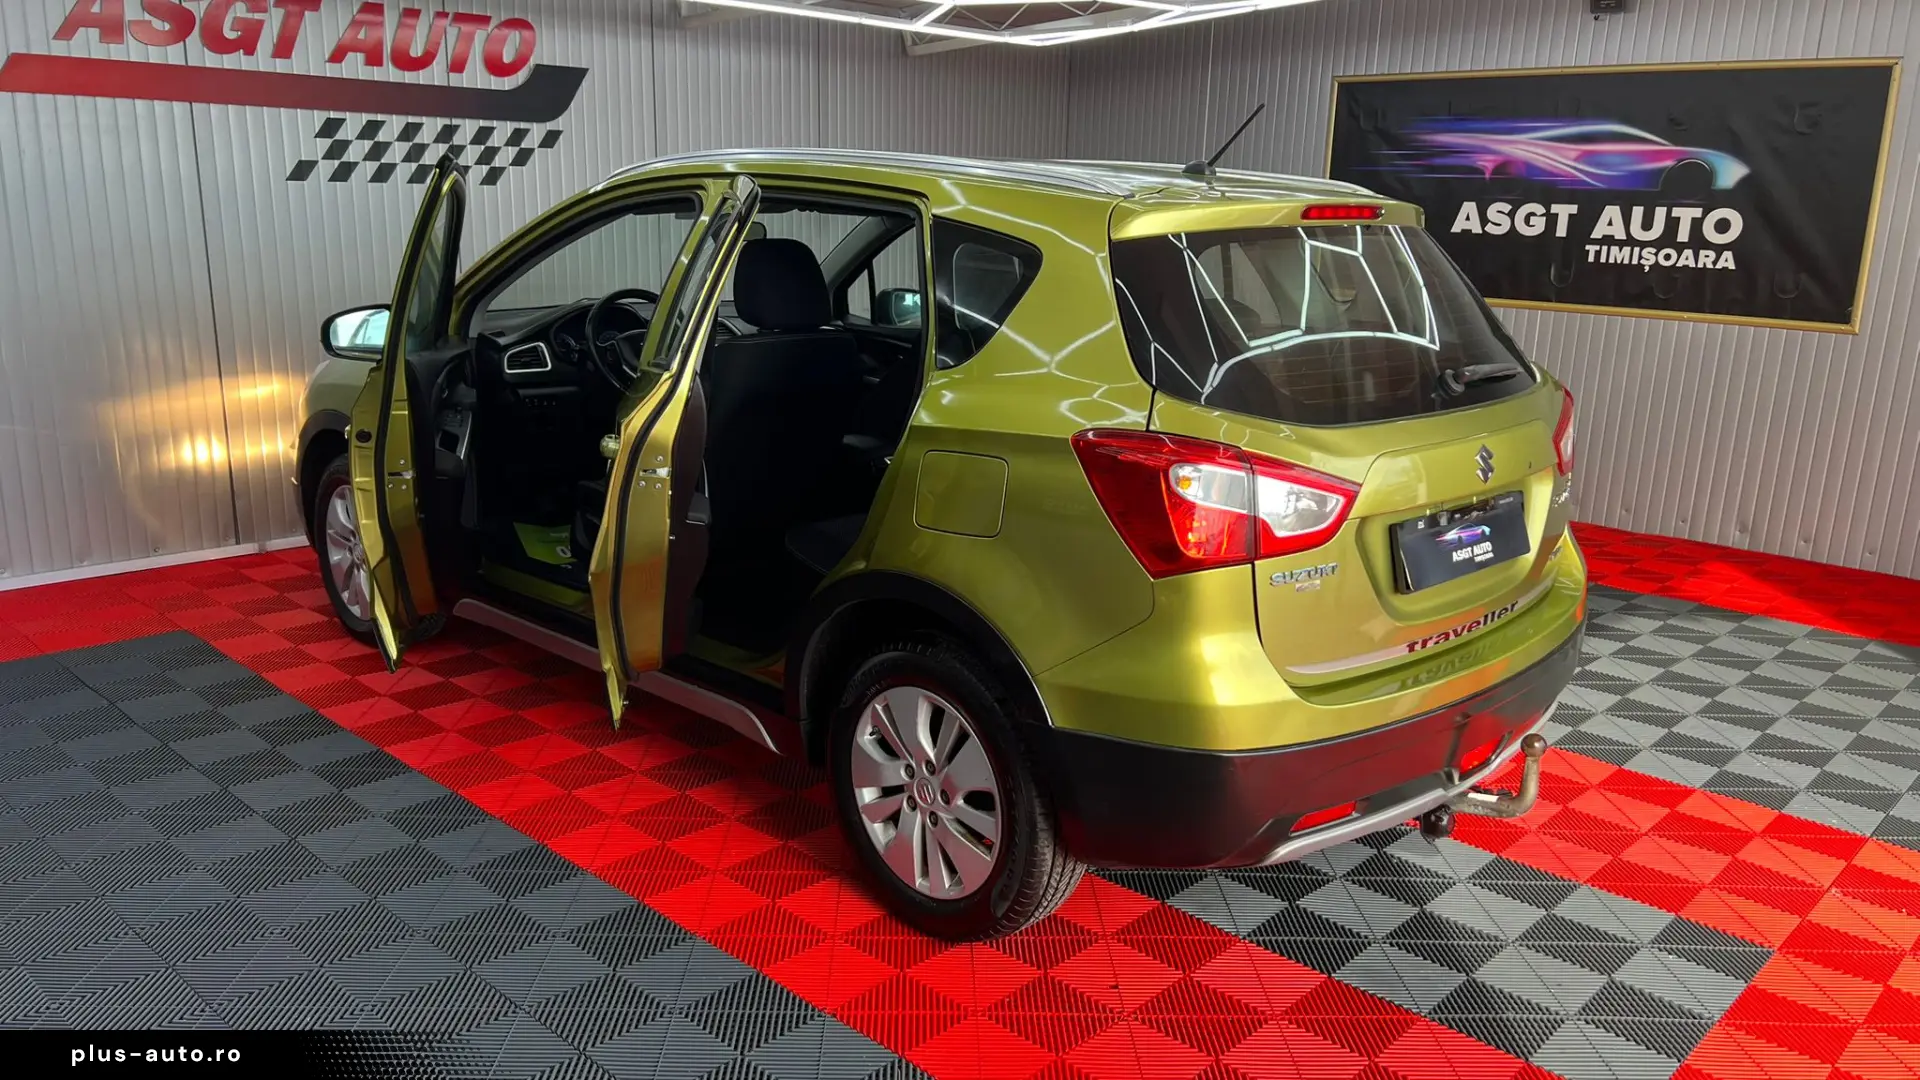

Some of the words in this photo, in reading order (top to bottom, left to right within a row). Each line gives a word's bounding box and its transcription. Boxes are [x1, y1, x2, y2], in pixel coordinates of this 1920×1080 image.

[52, 0, 320, 59] ASGT
[326, 2, 537, 78] AUTO
[1450, 201, 1578, 237] ASGT
[1590, 205, 1743, 244] AUTO
[1452, 546, 1473, 562] ASGT
[1473, 541, 1492, 556] AUTO
[1269, 562, 1338, 586] SUZUKI
